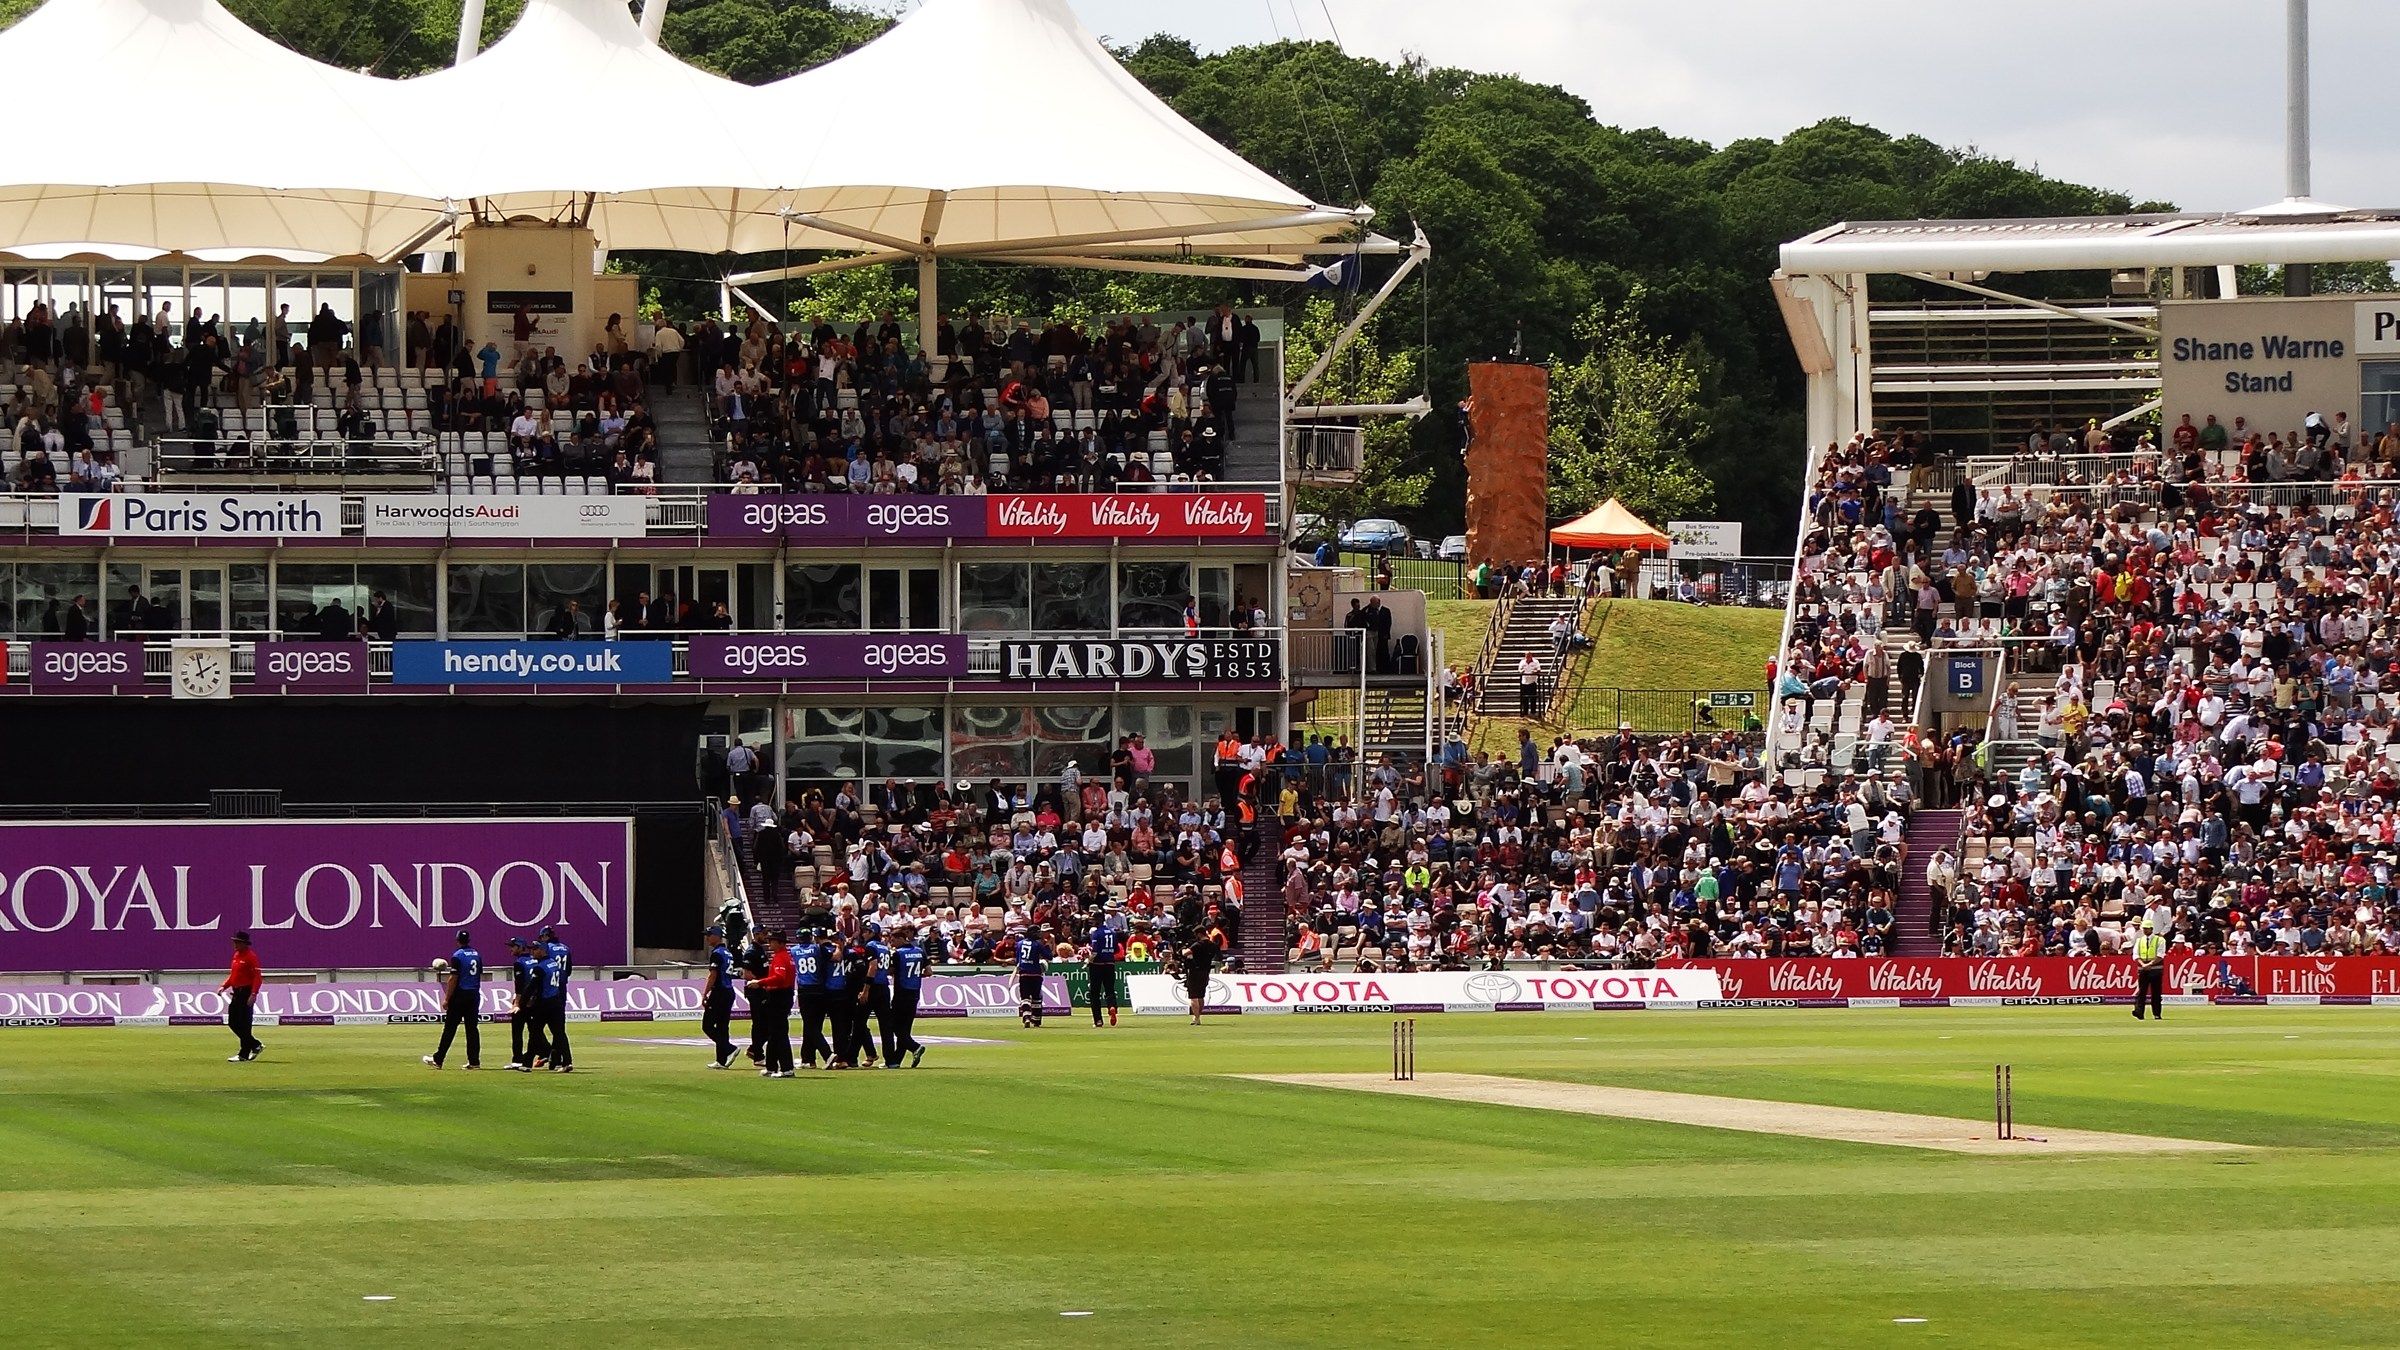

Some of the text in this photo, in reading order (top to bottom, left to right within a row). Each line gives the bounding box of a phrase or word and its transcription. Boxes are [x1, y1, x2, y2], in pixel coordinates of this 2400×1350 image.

[2173, 336, 2344, 361] Shane Warne
[2225, 371, 2292, 393] Stand
[125, 498, 322, 532] Paris Smith
[376, 505, 519, 518] HarwoodsAudi
[744, 503, 826, 533] ageas
[867, 504, 949, 534] ageas
[999, 497, 1067, 534] Vitality
[1092, 497, 1160, 534] Vitality
[1184, 497, 1252, 534] Vitality
[445, 649, 621, 676] hendy.co.uk
[724, 645, 807, 674] ageas
[864, 644, 946, 674] ageas
[1008, 643, 1207, 679] HARDYS
[1214, 643, 1272, 658] ESTD
[45, 651, 128, 681] ageas
[268, 651, 351, 681] ageas
[1214, 662, 1272, 677] 1853
[1960, 674, 1972, 688] B
[249, 861, 611, 931] LONDON
[1104, 935, 1113, 947] 11
[470, 960, 477, 975] 3
[798, 957, 817, 974] 88
[878, 953, 890, 970] 38
[907, 962, 921, 978] 74
[1527, 977, 1678, 999] TOYOTA
[1770, 960, 1843, 998] Vitality
[1870, 960, 1942, 998] Vitality
[1969, 960, 2042, 997] Vitality
[2272, 969, 2336, 994] E-Lites
[290, 988, 441, 1014] LONDON
[1236, 981, 1390, 1003] TOYOTA
[8, 1018, 57, 1026] ETIHAD
